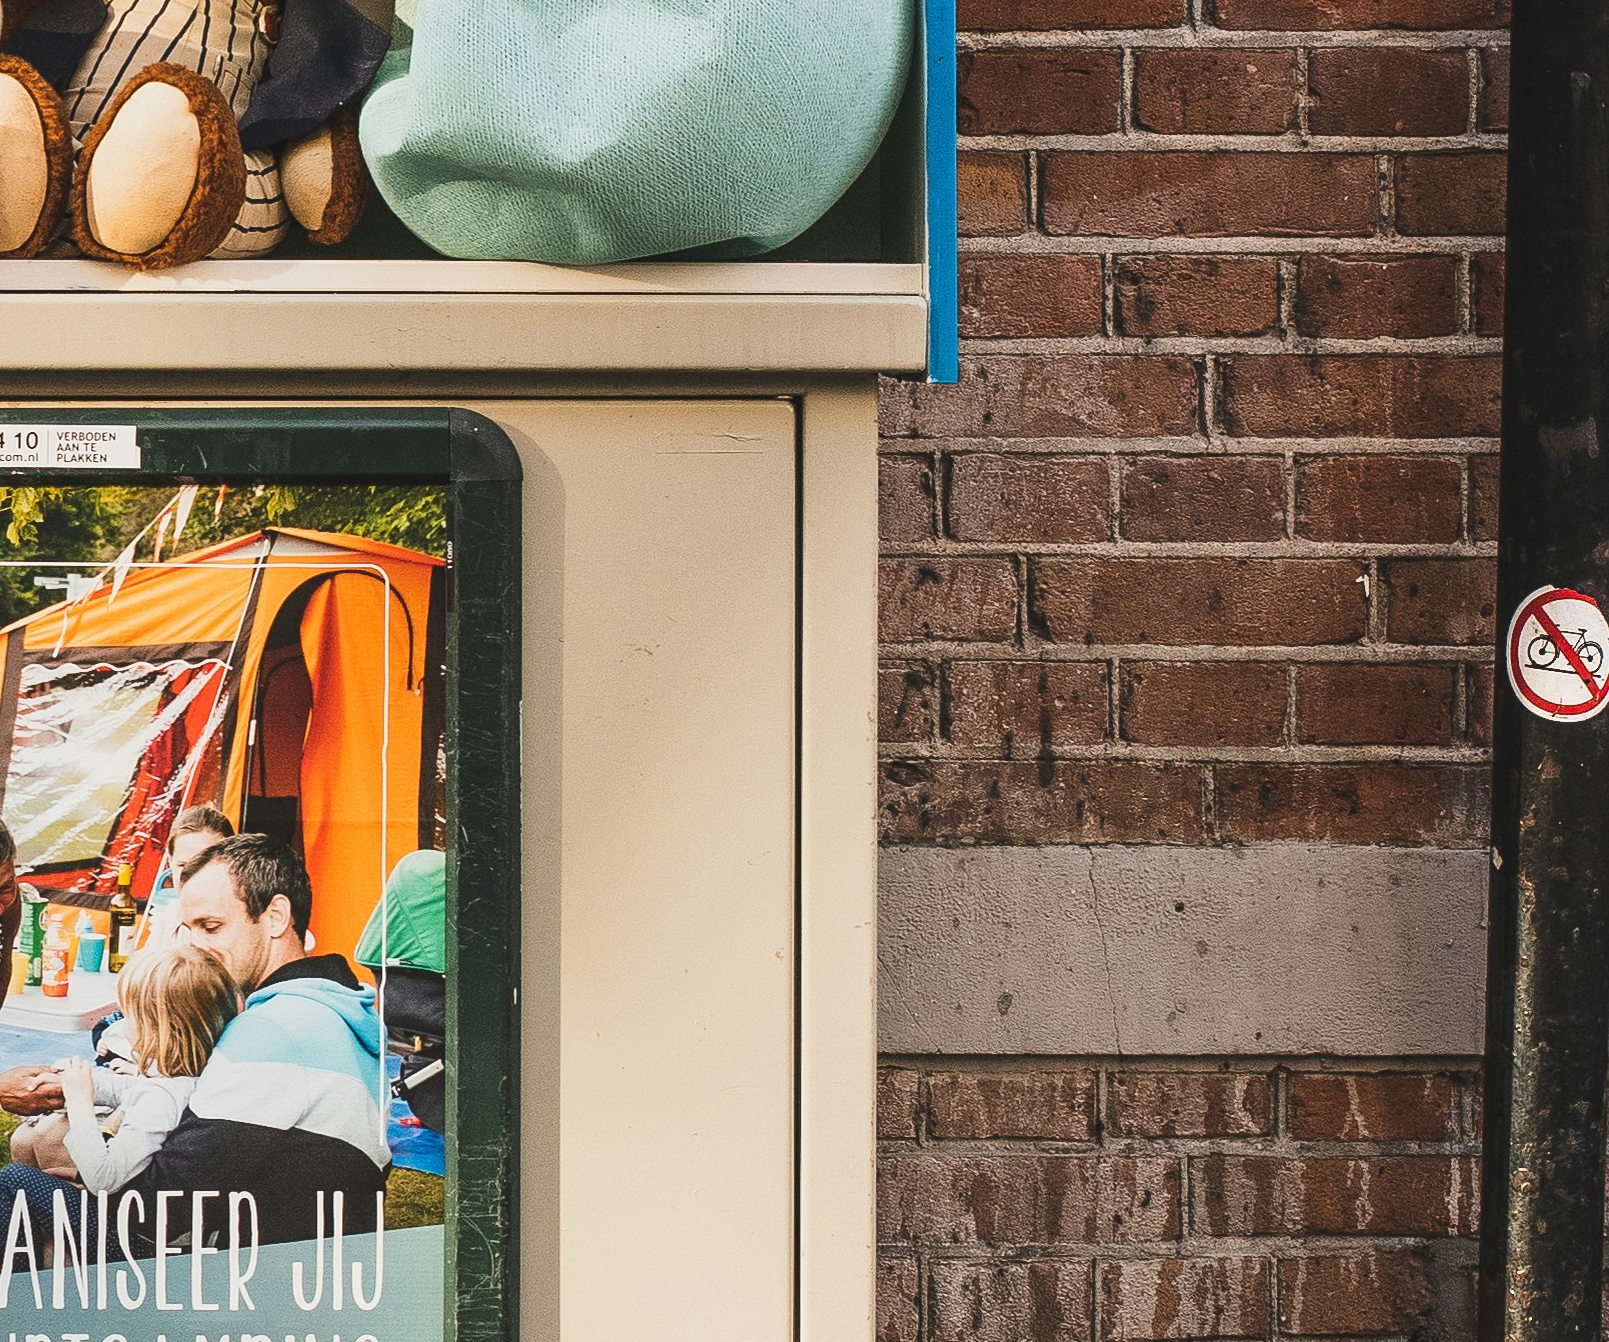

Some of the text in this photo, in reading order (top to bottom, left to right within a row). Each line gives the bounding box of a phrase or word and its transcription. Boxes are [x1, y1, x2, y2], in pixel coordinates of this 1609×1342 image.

[15, 431, 39, 450] 10
[57, 431, 117, 442] VERBODEN
[57, 443, 97, 453] AAN TE
[57, 453, 108, 463] PLAKKEN
[292, 1190, 385, 1311] JIJ
